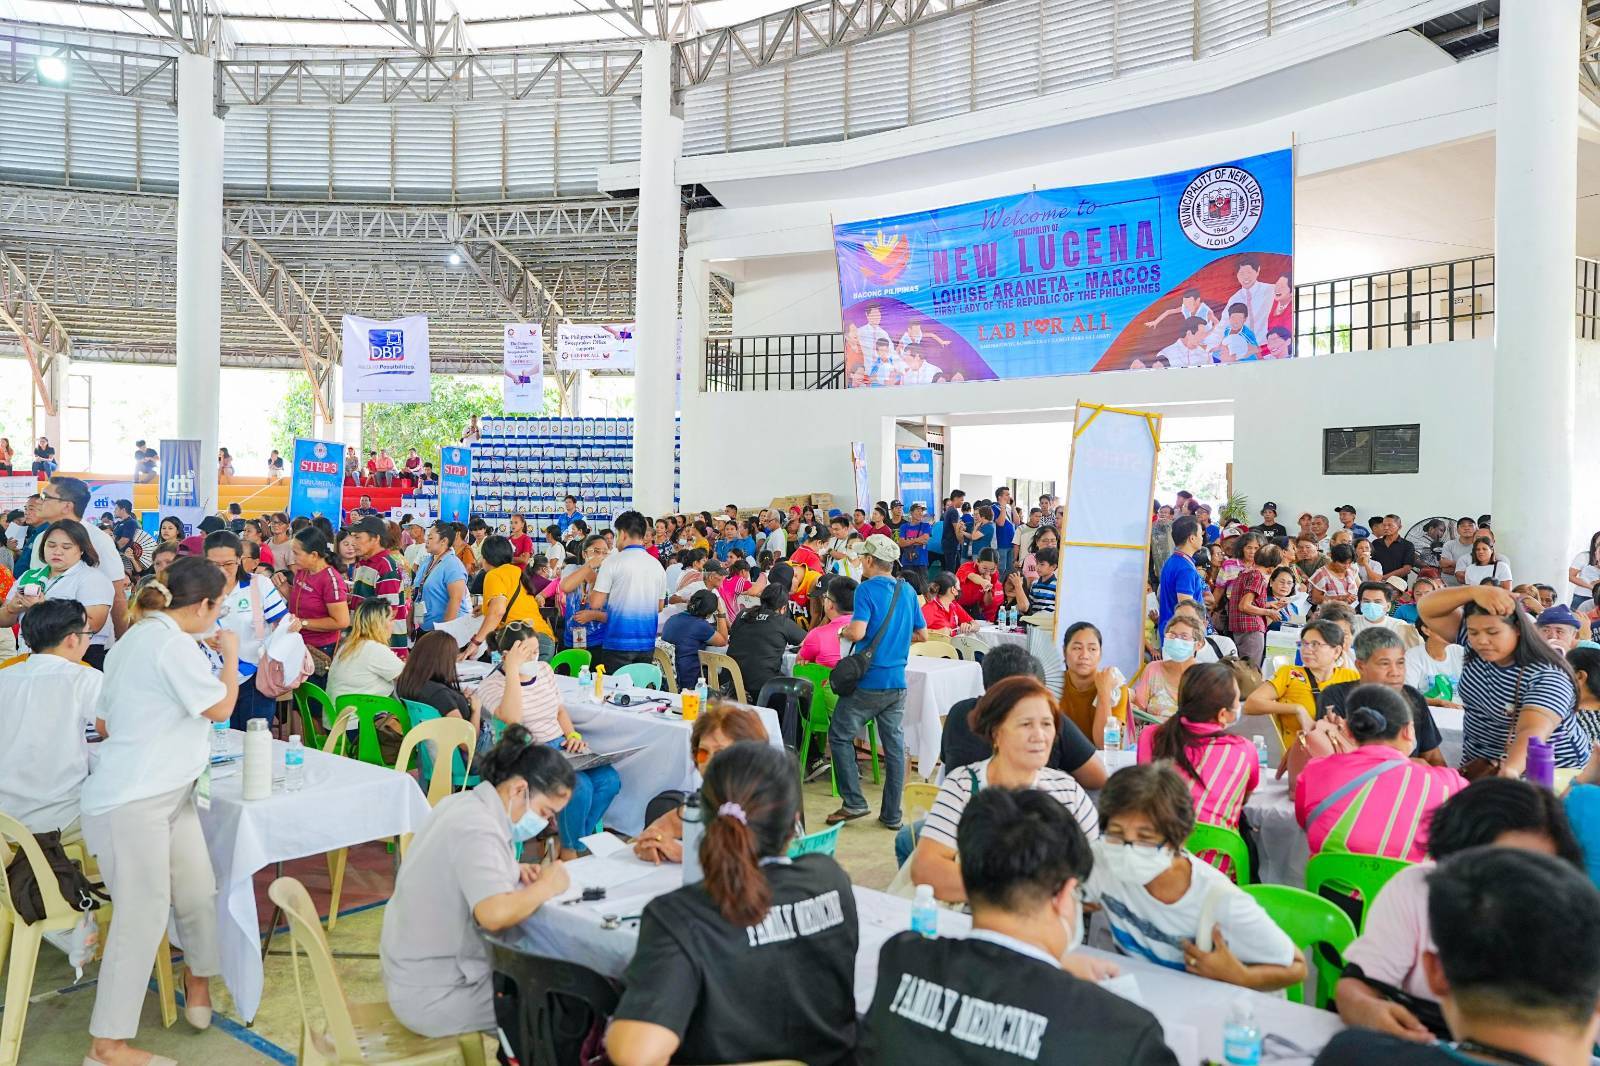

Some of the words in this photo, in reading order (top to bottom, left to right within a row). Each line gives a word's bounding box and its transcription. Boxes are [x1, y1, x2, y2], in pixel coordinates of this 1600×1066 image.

[1181, 173, 1212, 228] MUNICIPALITY
[1214, 169, 1226, 180] OF
[1228, 169, 1248, 182] NEW
[1245, 180, 1261, 217] LUCENA
[981, 207, 1071, 230] Welcome
[1077, 199, 1097, 216] to
[1013, 225, 1050, 237] MUNICIPALITY
[1052, 223, 1059, 232] OF
[1206, 235, 1235, 246] ILOILO
[933, 241, 998, 284] NEW
[1018, 220, 1155, 273] LUCENA
[883, 285, 919, 295] PILIPINAS
[932, 285, 987, 305] LOUISE
[993, 275, 1068, 300] ARANETA
[1086, 264, 1161, 289] MARCOS
[935, 305, 957, 316] FIRST
[960, 302, 981, 314] LADY
[984, 300, 994, 311] OF
[997, 298, 1014, 309] THE
[1017, 293, 1060, 307] REPUBLIC
[1063, 291, 1074, 302] OF
[1078, 289, 1097, 300] THE
[1100, 282, 1161, 299] PHILIPPINES
[977, 321, 1017, 342] LAB
[1071, 311, 1113, 333] ALL
[371, 346, 402, 359] DBP
[301, 460, 329, 473] STEP
[330, 463, 337, 474] 3
[445, 465, 463, 475] STEP
[167, 475, 193, 493] dti
[94, 498, 109, 507] dti
[794, 890, 845, 936] MEDICINE
[889, 973, 960, 1032] FAMILY
[950, 995, 1049, 1061] MEDICINE
